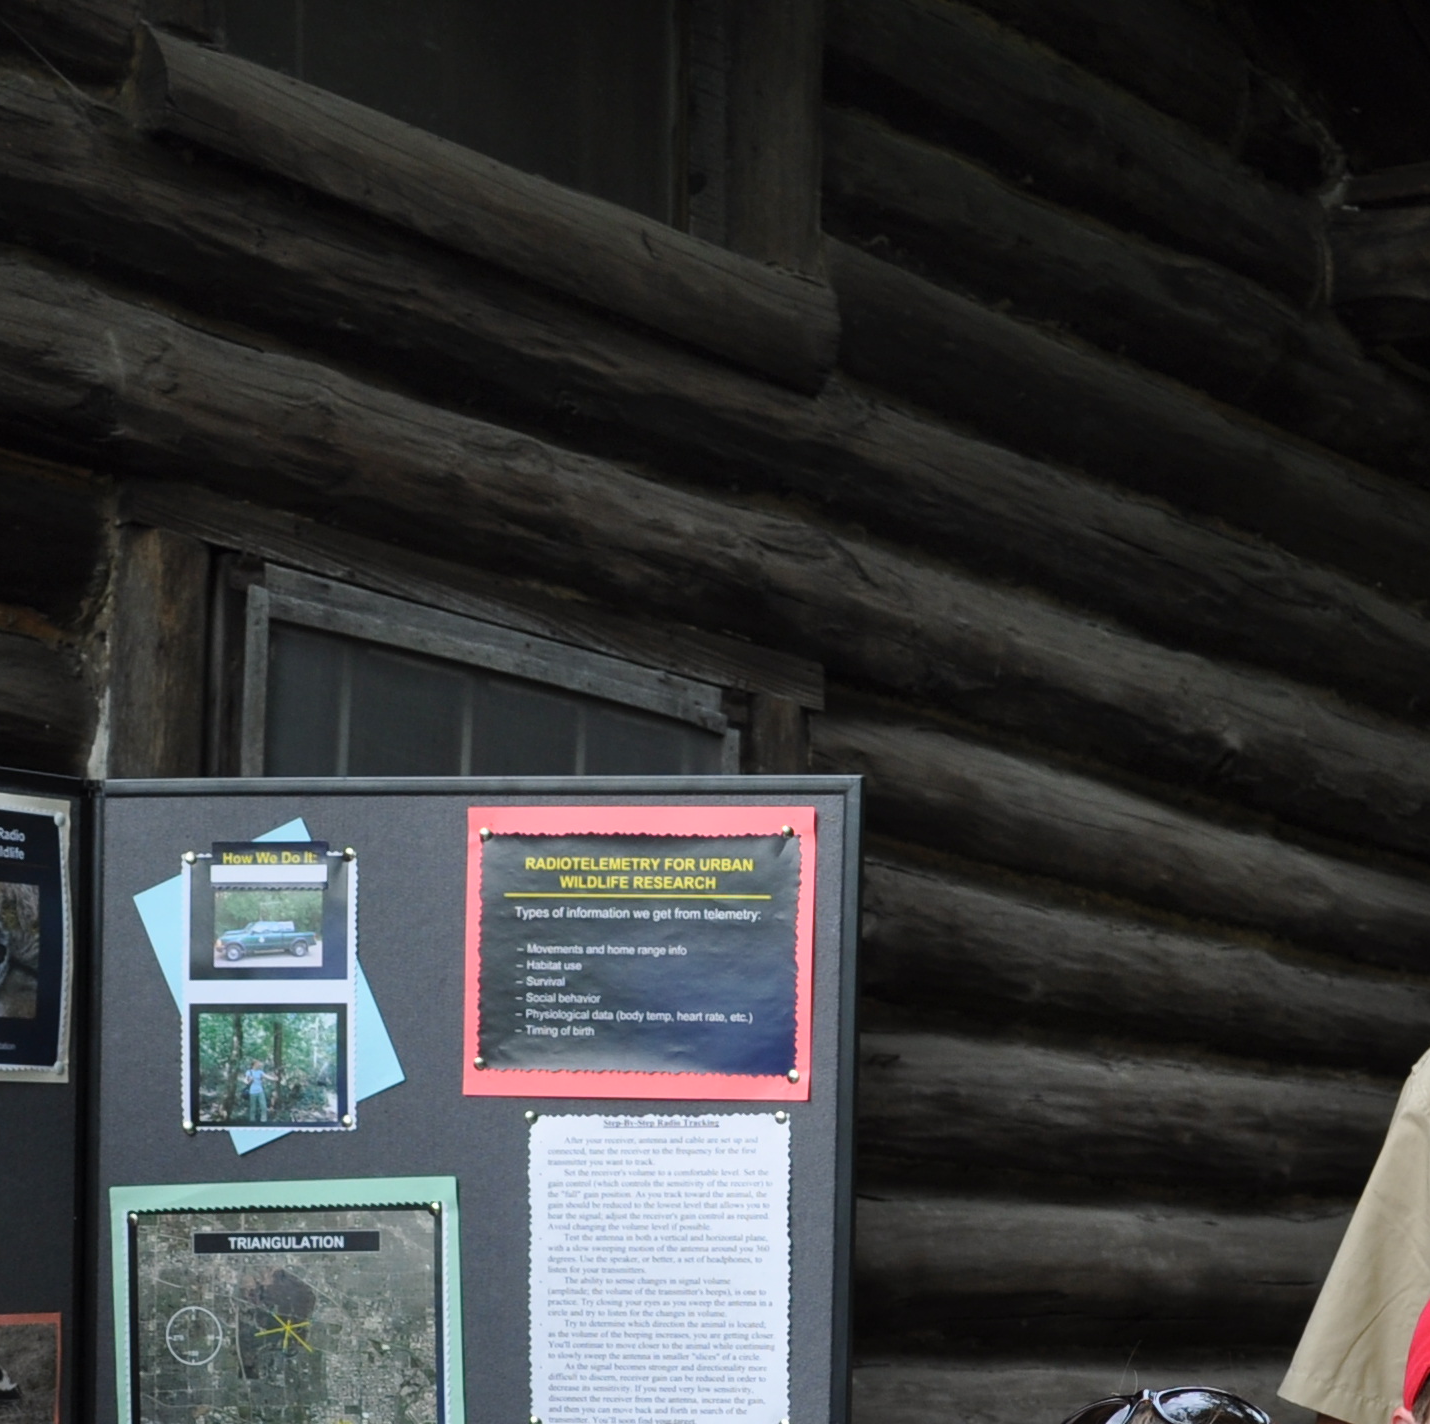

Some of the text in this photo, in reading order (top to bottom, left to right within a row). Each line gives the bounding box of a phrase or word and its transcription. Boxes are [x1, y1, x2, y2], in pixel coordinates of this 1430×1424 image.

[222, 852, 318, 864] How We Do It:
[525, 857, 753, 871] RADIOTELEMETRY FOR URBAN
[559, 875, 716, 889] WILDLIFE RESEARCH
[514, 905, 761, 922] Types of information we get from telemetry:
[526, 943, 687, 957] Movements and home range info
[526, 960, 582, 970] Habitat use
[526, 975, 565, 986] Survival
[525, 992, 601, 1003] Social behavior
[524, 1024, 595, 1037] Timing of birth
[228, 1235, 344, 1249] TRIANGULATION
